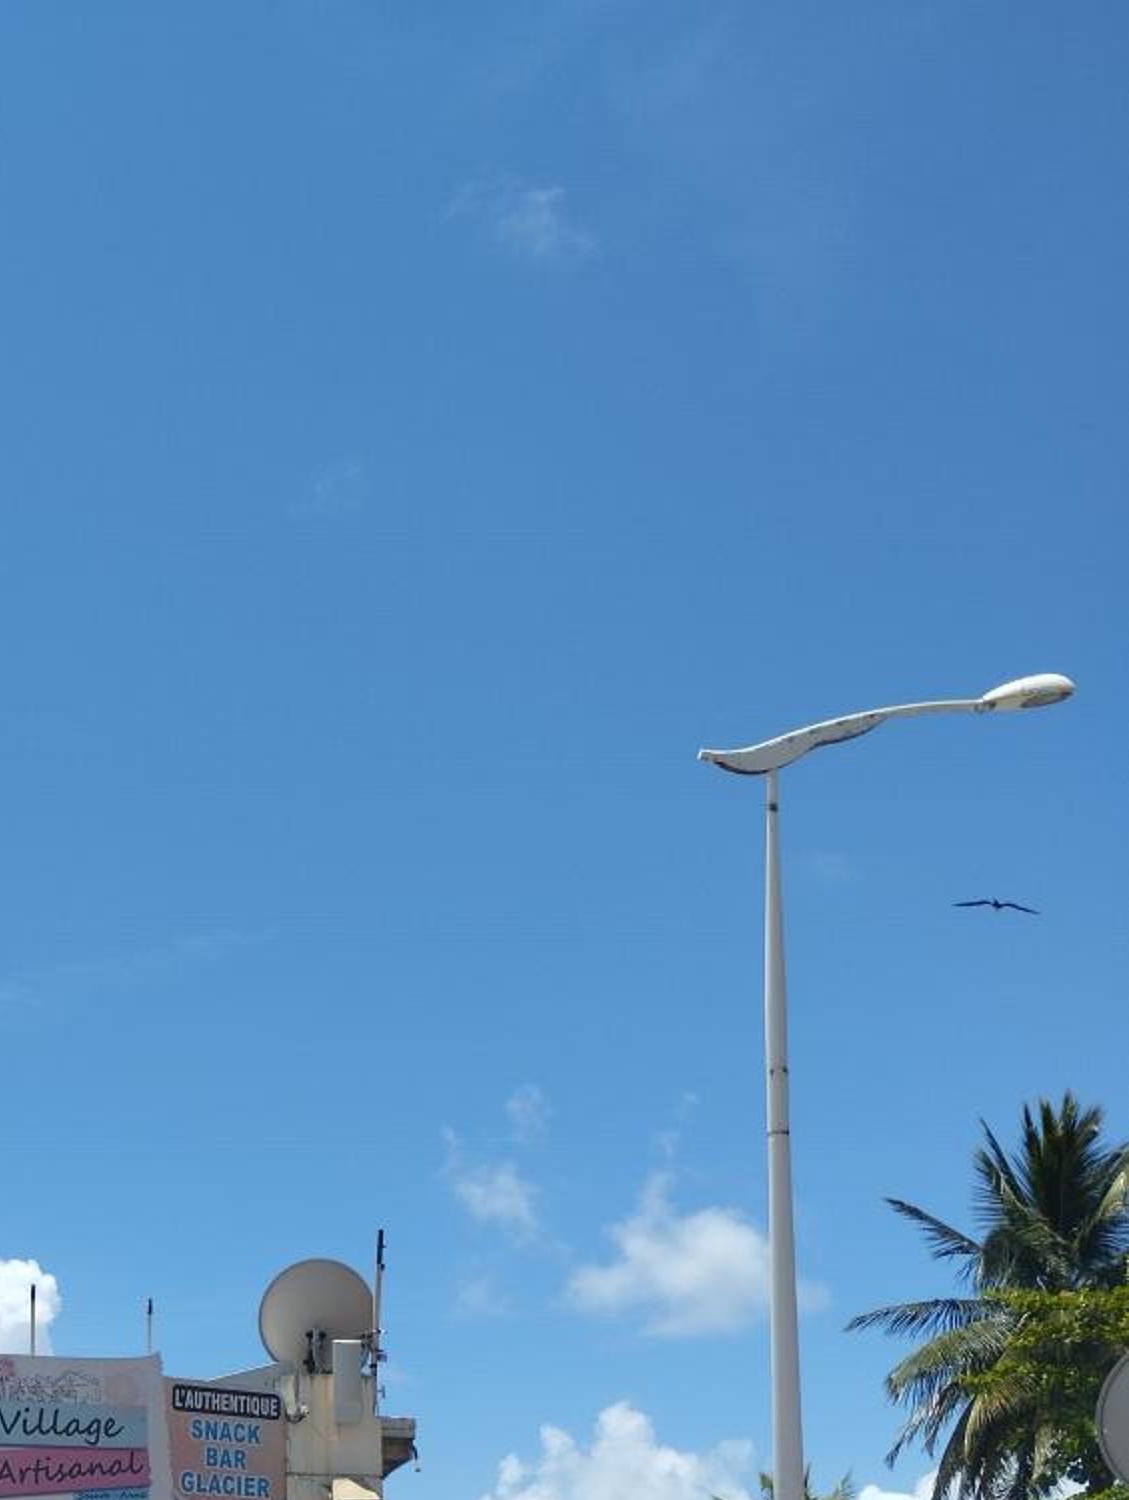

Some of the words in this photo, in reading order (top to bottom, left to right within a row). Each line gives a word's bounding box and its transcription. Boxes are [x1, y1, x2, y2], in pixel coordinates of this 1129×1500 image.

[173, 1387, 280, 1418] L'AUTHENTIQUE
[190, 1418, 261, 1444] SNACK
[205, 1445, 247, 1470] BAR
[180, 1470, 270, 1498] GLACIER
